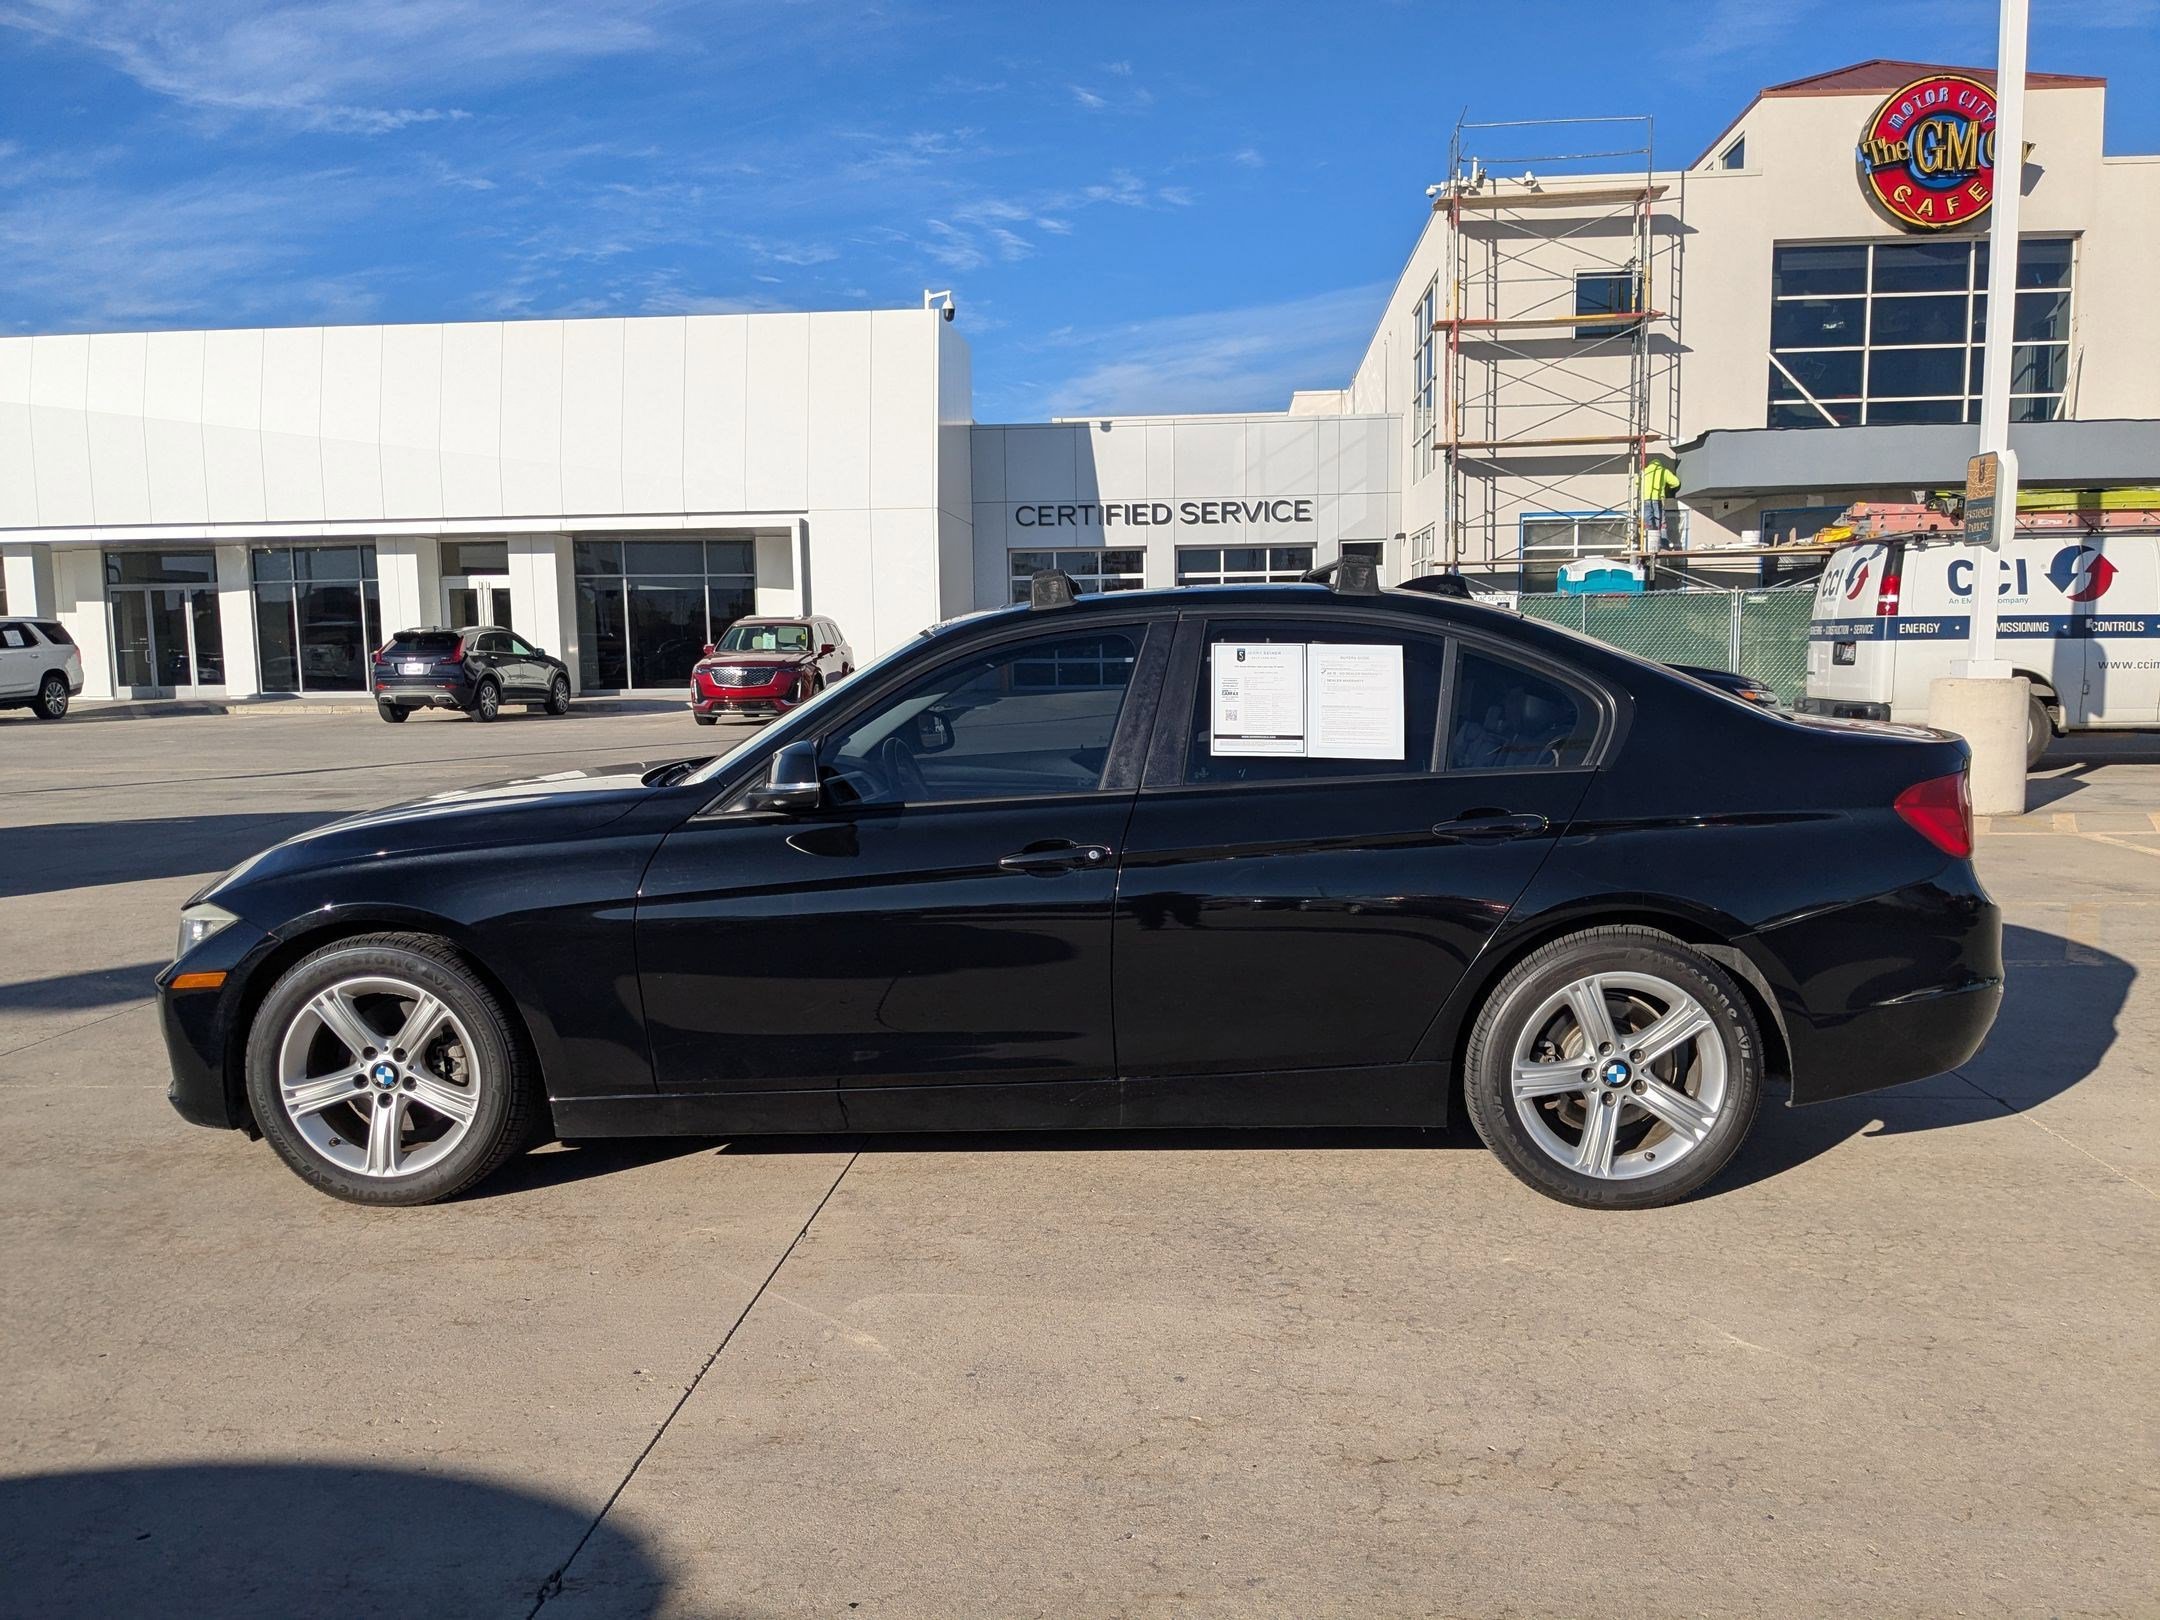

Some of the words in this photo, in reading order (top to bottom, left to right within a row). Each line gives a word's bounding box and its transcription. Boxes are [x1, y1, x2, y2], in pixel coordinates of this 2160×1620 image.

[1888, 86, 1949, 130] MOTOR
[1958, 90, 1996, 125] CITY
[1862, 137, 1910, 166] The
[1893, 182, 1988, 217] CAFE
[1015, 503, 1172, 527] CERTIFIED
[1180, 499, 1314, 525] SERVICE
[1822, 568, 1844, 597] CCI
[1998, 597, 2029, 605] ompany
[1853, 624, 1874, 634] SERVICE
[1899, 623, 1941, 634] ENERGY
[1996, 621, 2050, 633] MISSIONING
[2092, 621, 2145, 632] CONTROLS
